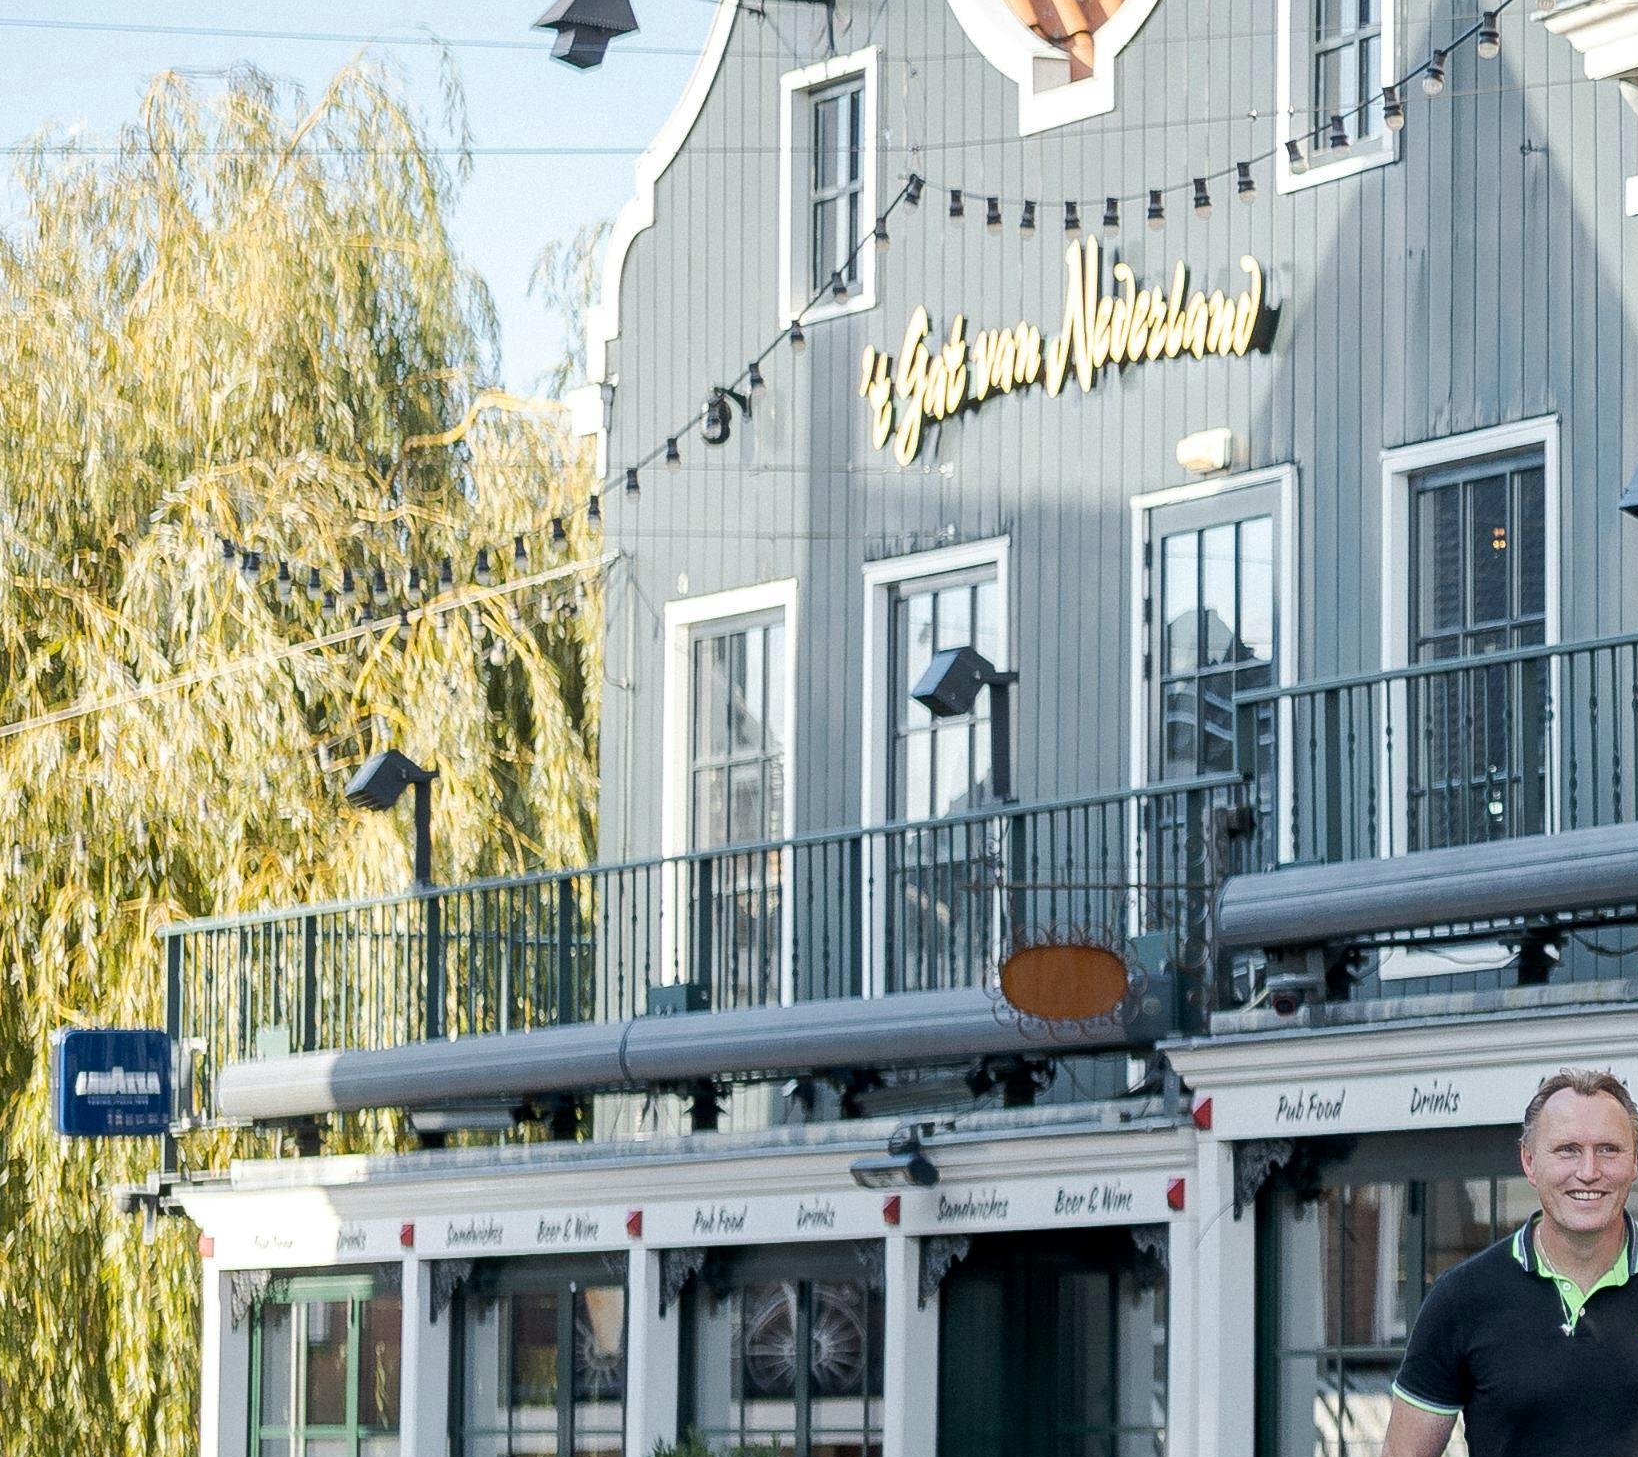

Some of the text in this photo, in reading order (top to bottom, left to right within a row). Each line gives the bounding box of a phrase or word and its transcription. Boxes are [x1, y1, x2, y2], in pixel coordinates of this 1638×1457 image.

[894, 304, 967, 467] Gat
[972, 320, 1042, 401] van
[1045, 233, 1262, 399] Nederland
[1276, 1078, 1461, 1123] Pub Food Drinks
[1054, 1184, 1085, 1216] Beer
